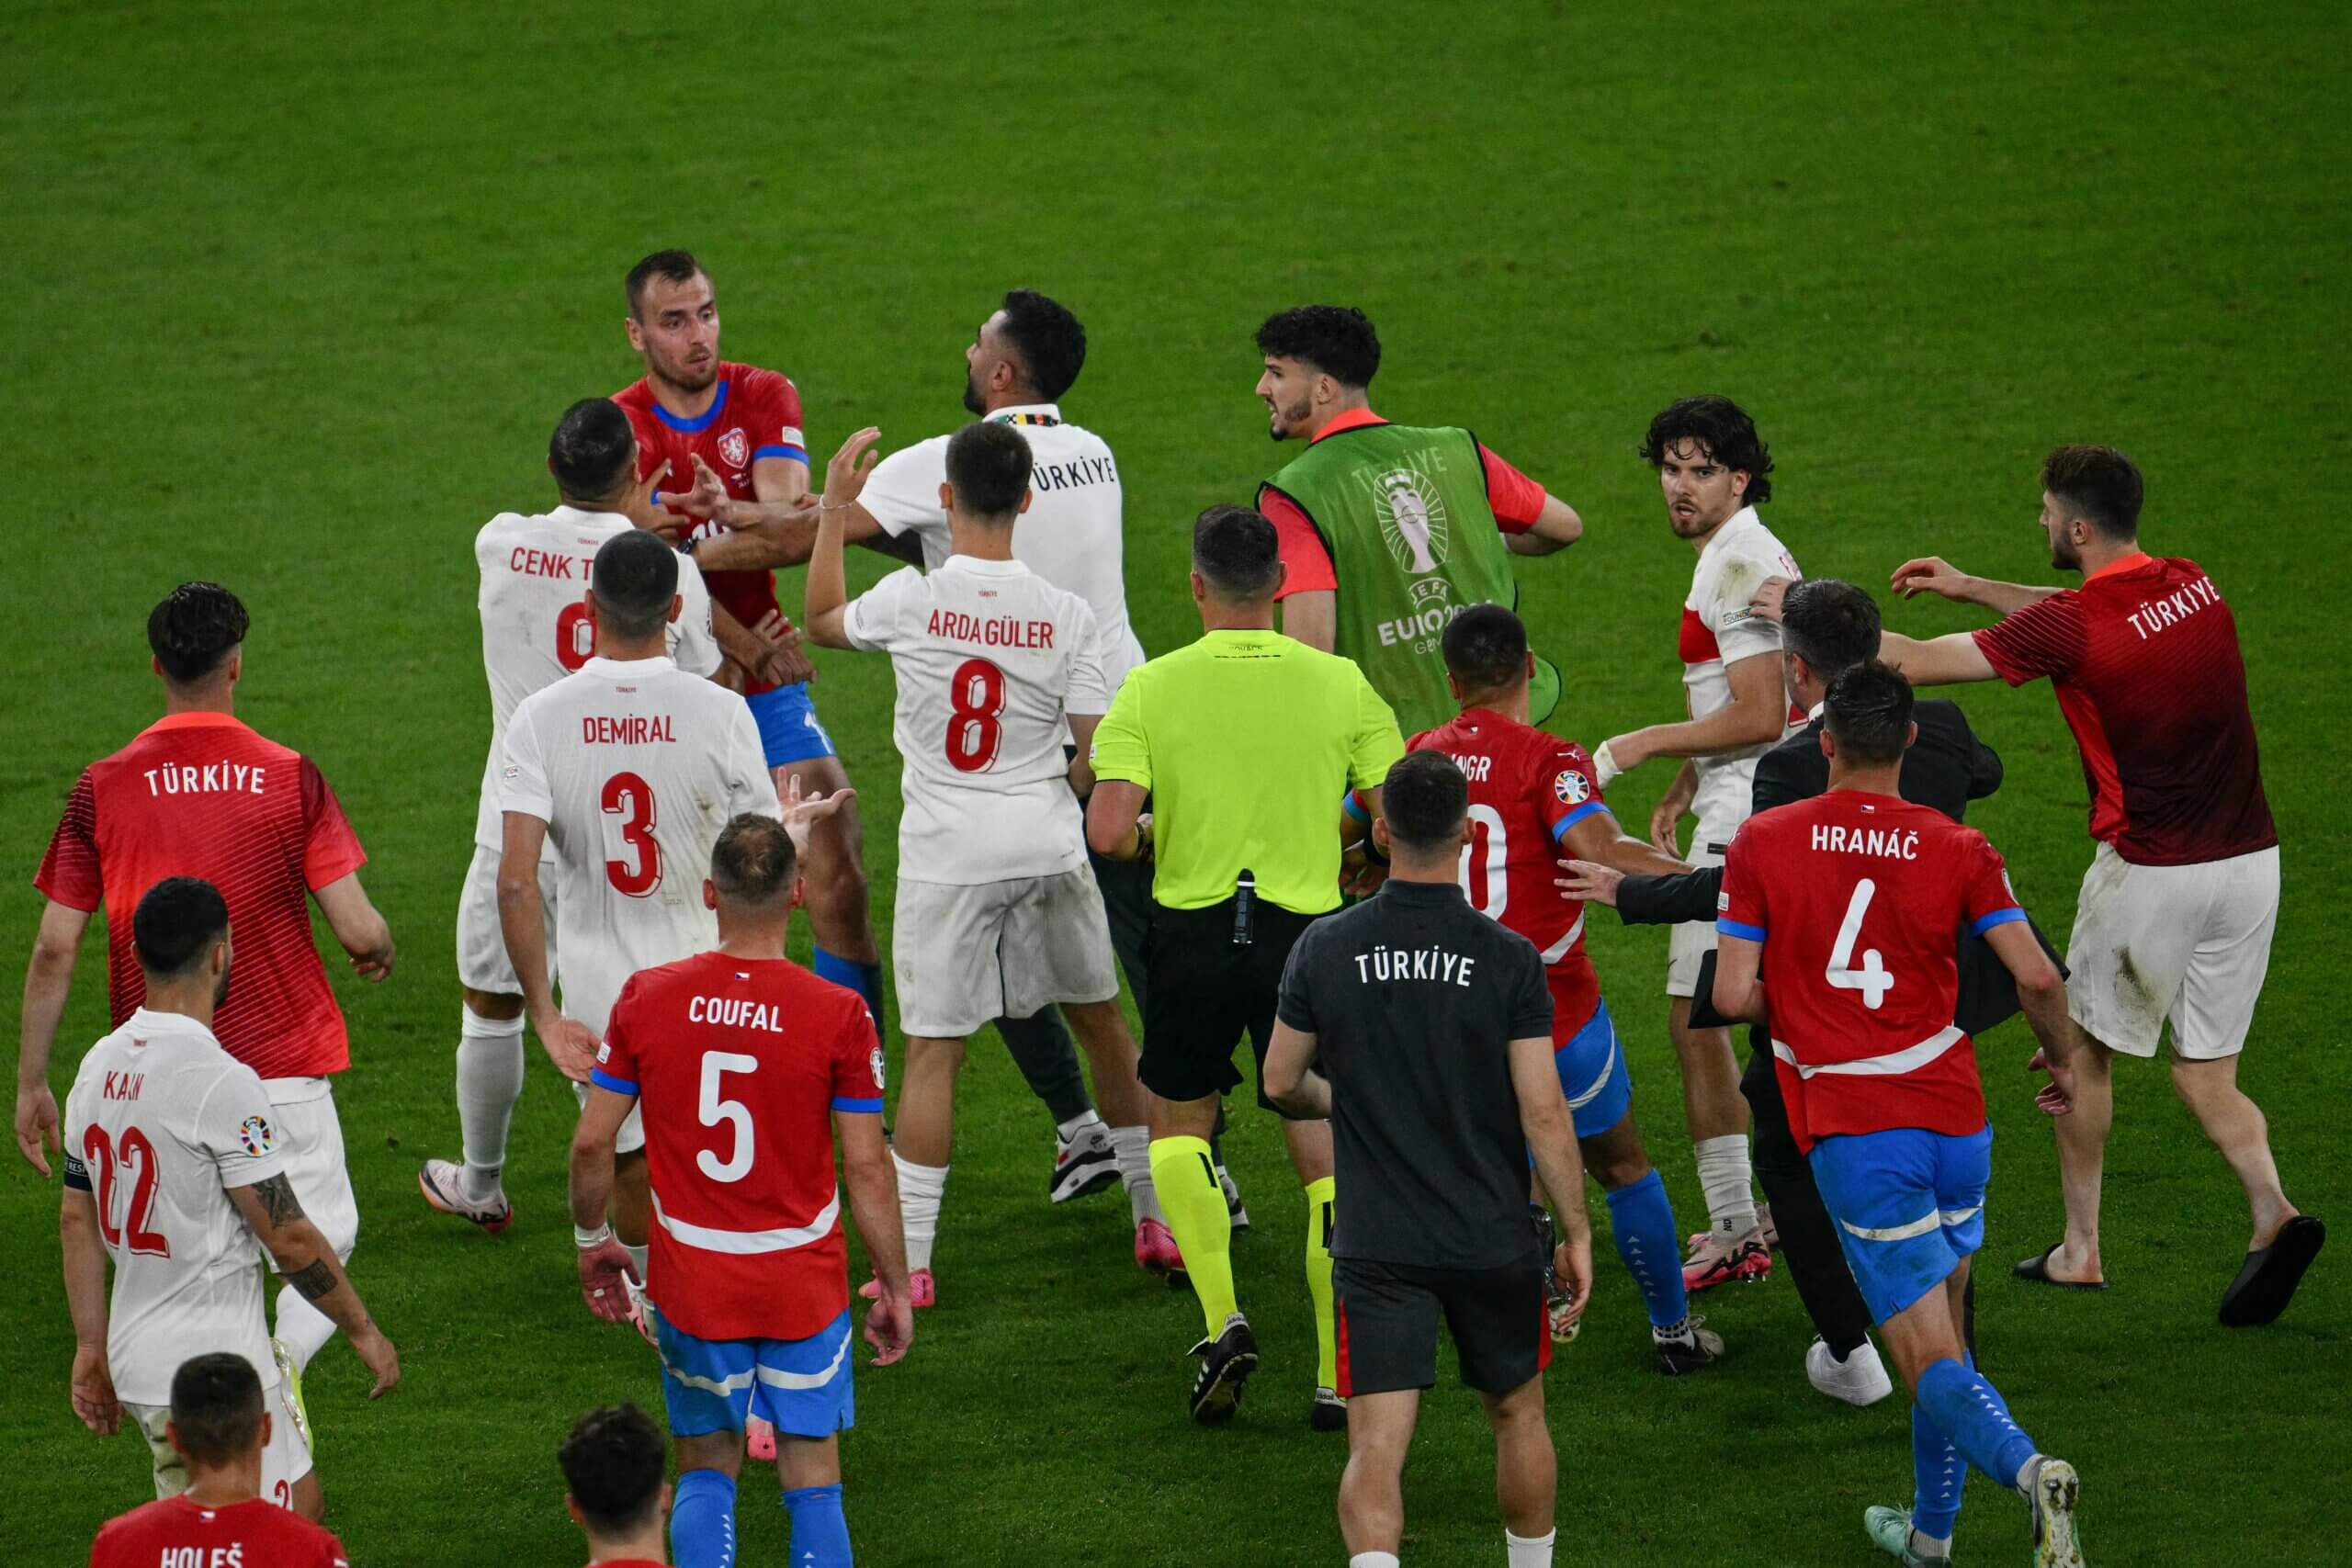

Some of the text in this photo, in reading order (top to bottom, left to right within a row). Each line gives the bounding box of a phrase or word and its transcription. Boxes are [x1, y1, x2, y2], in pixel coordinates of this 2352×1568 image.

[1032, 456, 1114, 491] ÜRKİYE
[511, 547, 574, 580] CENK
[2127, 575, 2221, 639] TÜRKİYE
[928, 608, 1054, 649] ARDA GÜLER
[582, 713, 676, 745] DEMİRAL
[945, 659, 1006, 773] 8
[143, 759, 266, 797] TÜRKİYE
[1452, 754, 1491, 782] NGR
[601, 772, 664, 898] 3
[1812, 824, 1919, 861] HRANÁČ
[1826, 878, 1894, 1010] 4
[1354, 944, 1475, 987] TÜRKİYE
[689, 995, 784, 1033] COUFAL
[696, 1050, 759, 1183] 5
[83, 1122, 170, 1258] 22
[161, 1542, 243, 1568] HOLEŠ
